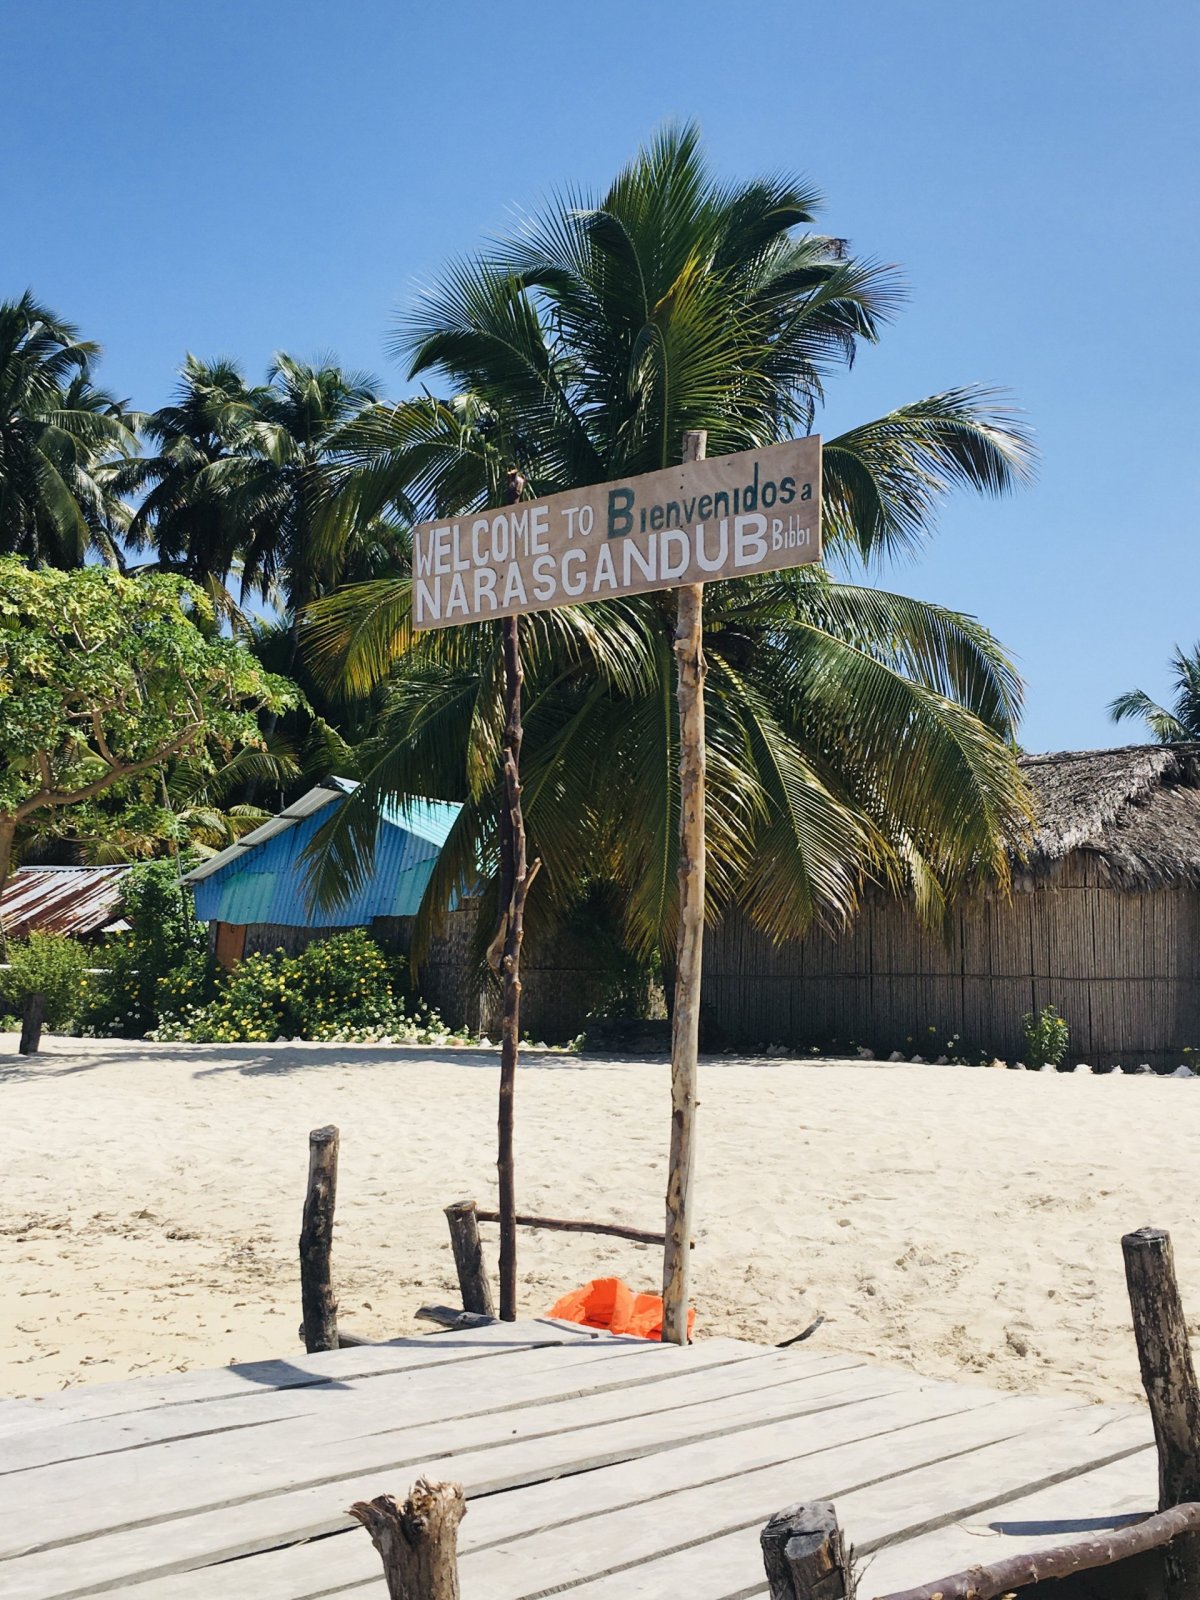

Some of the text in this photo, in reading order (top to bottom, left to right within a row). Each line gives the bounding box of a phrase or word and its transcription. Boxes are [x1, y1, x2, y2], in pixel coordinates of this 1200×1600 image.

[415, 461, 812, 578] WELCOME TO Bienvenidos a
[416, 513, 768, 622] NARASGANDUB
